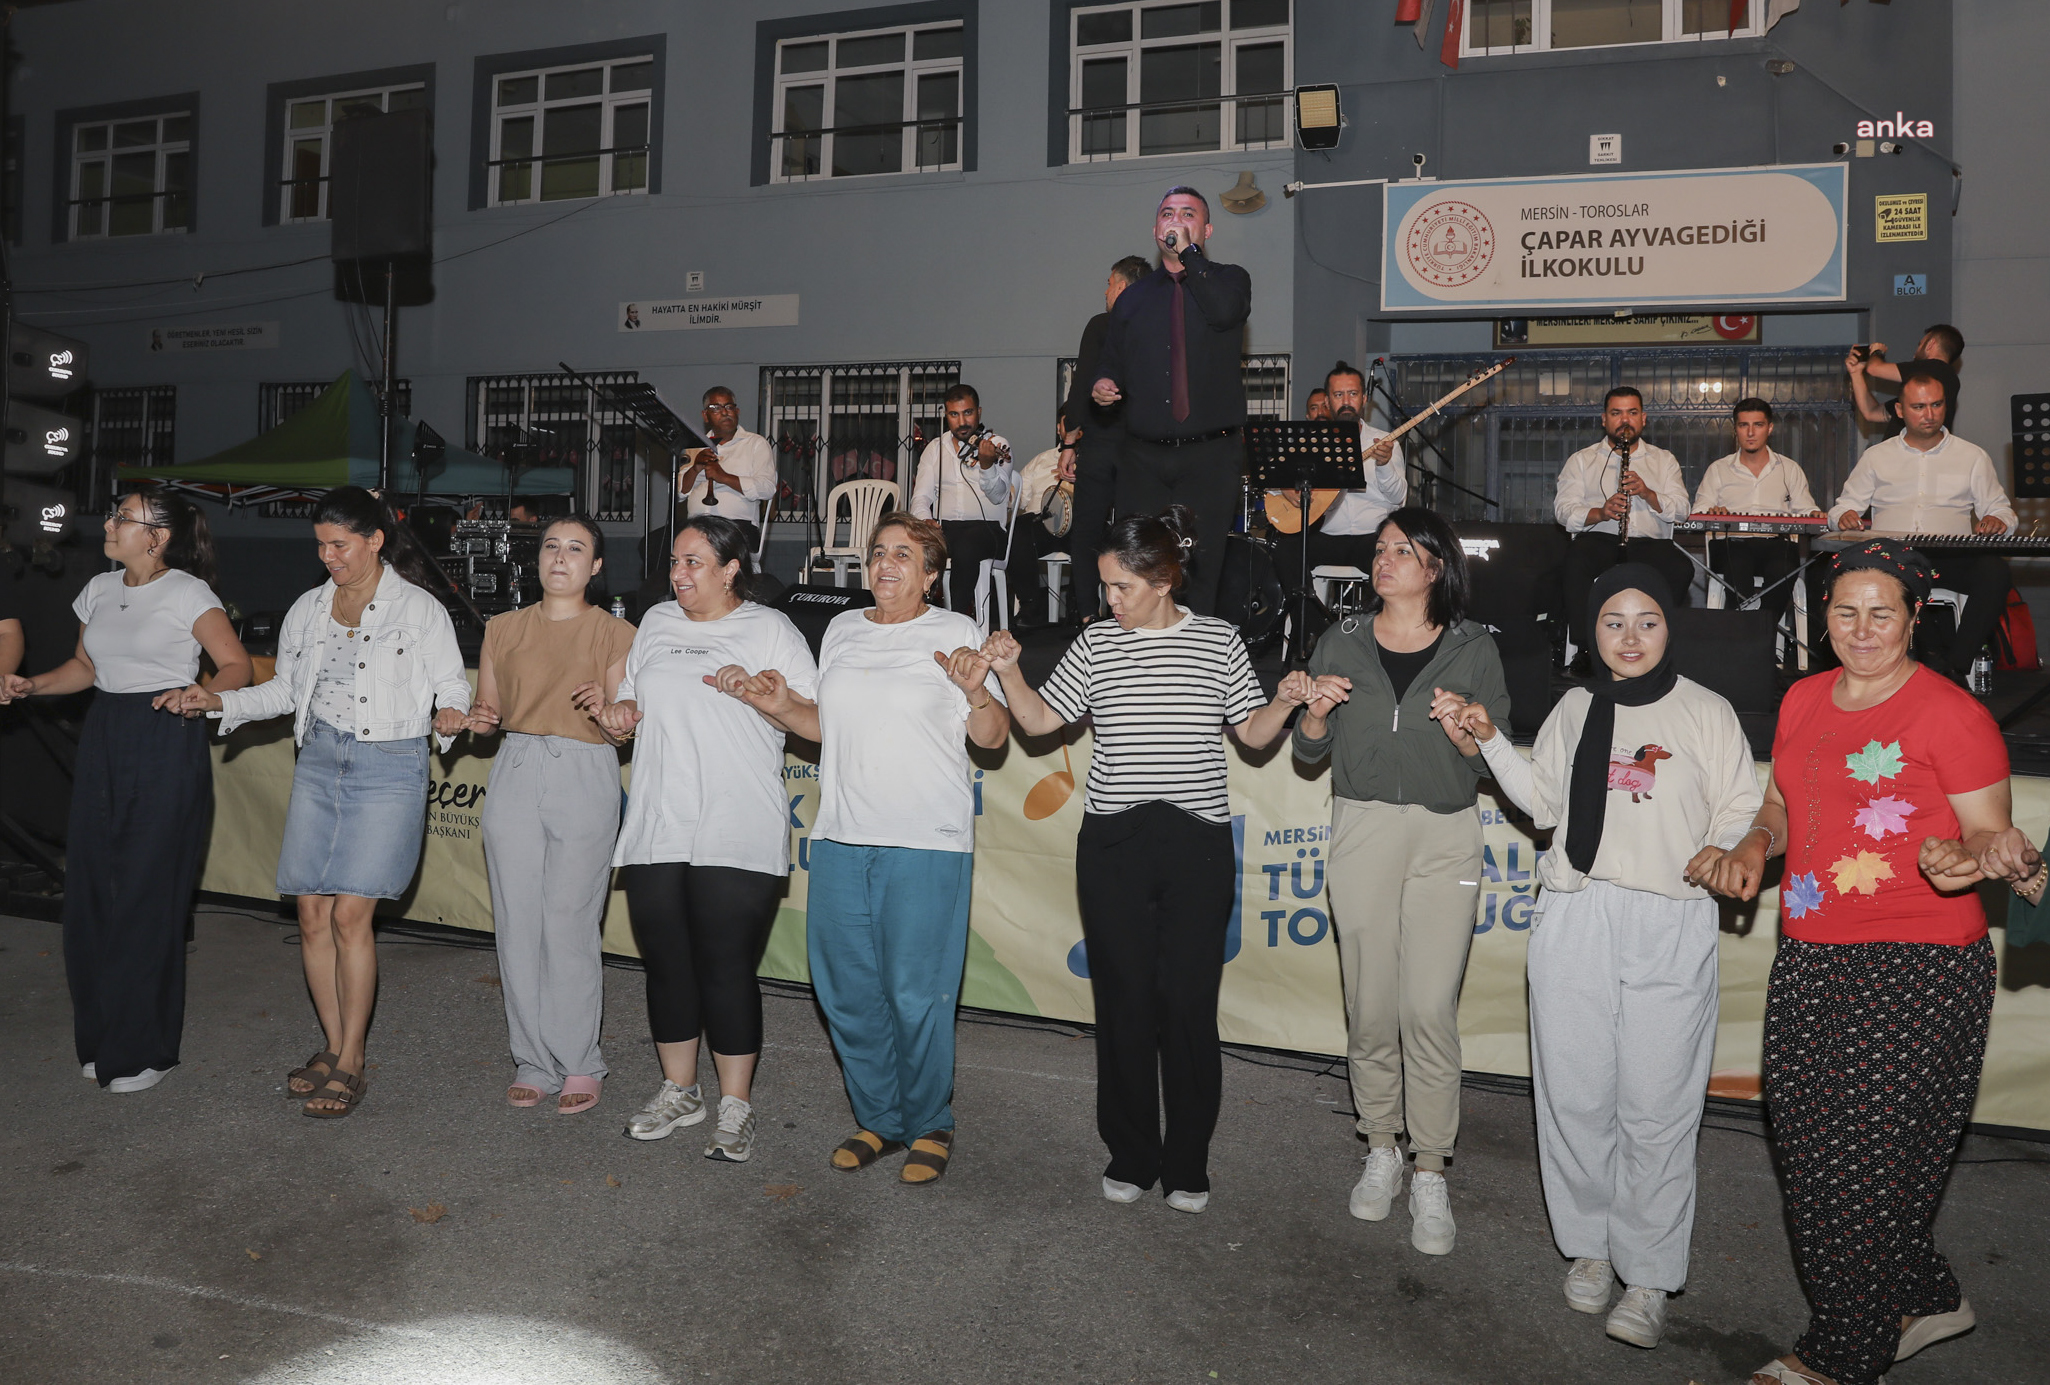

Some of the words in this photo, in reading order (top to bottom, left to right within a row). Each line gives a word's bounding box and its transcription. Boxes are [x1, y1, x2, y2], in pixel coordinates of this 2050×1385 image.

[1521, 204, 1569, 220] MERSİN
[1579, 203, 1649, 219] TOROSLAR
[1905, 207, 1921, 215] SAAT
[1520, 229, 1603, 256] ÇAPAR
[1609, 218, 1766, 248] AYVAGEDİĞİ
[1521, 255, 1644, 278] İLKOKULU
[1904, 275, 1915, 286] A
[1897, 286, 1922, 295] BLOK
[652, 304, 686, 314] HAYATTA
[688, 304, 699, 312] EN
[701, 301, 729, 312] HAKİKİ
[731, 300, 763, 311] MÜRŞİT
[689, 315, 721, 324] İLİMDİR.
[788, 592, 851, 605] ÇUKUROVA
[1619, 747, 1633, 755] one
[1617, 770, 1642, 792] dog
[426, 780, 486, 809] eçer
[440, 811, 480, 829] BÜYÜKŞ
[427, 825, 470, 839] BAŞKANI
[1262, 847, 1325, 901] TÜ
[1261, 907, 1330, 948] TO
